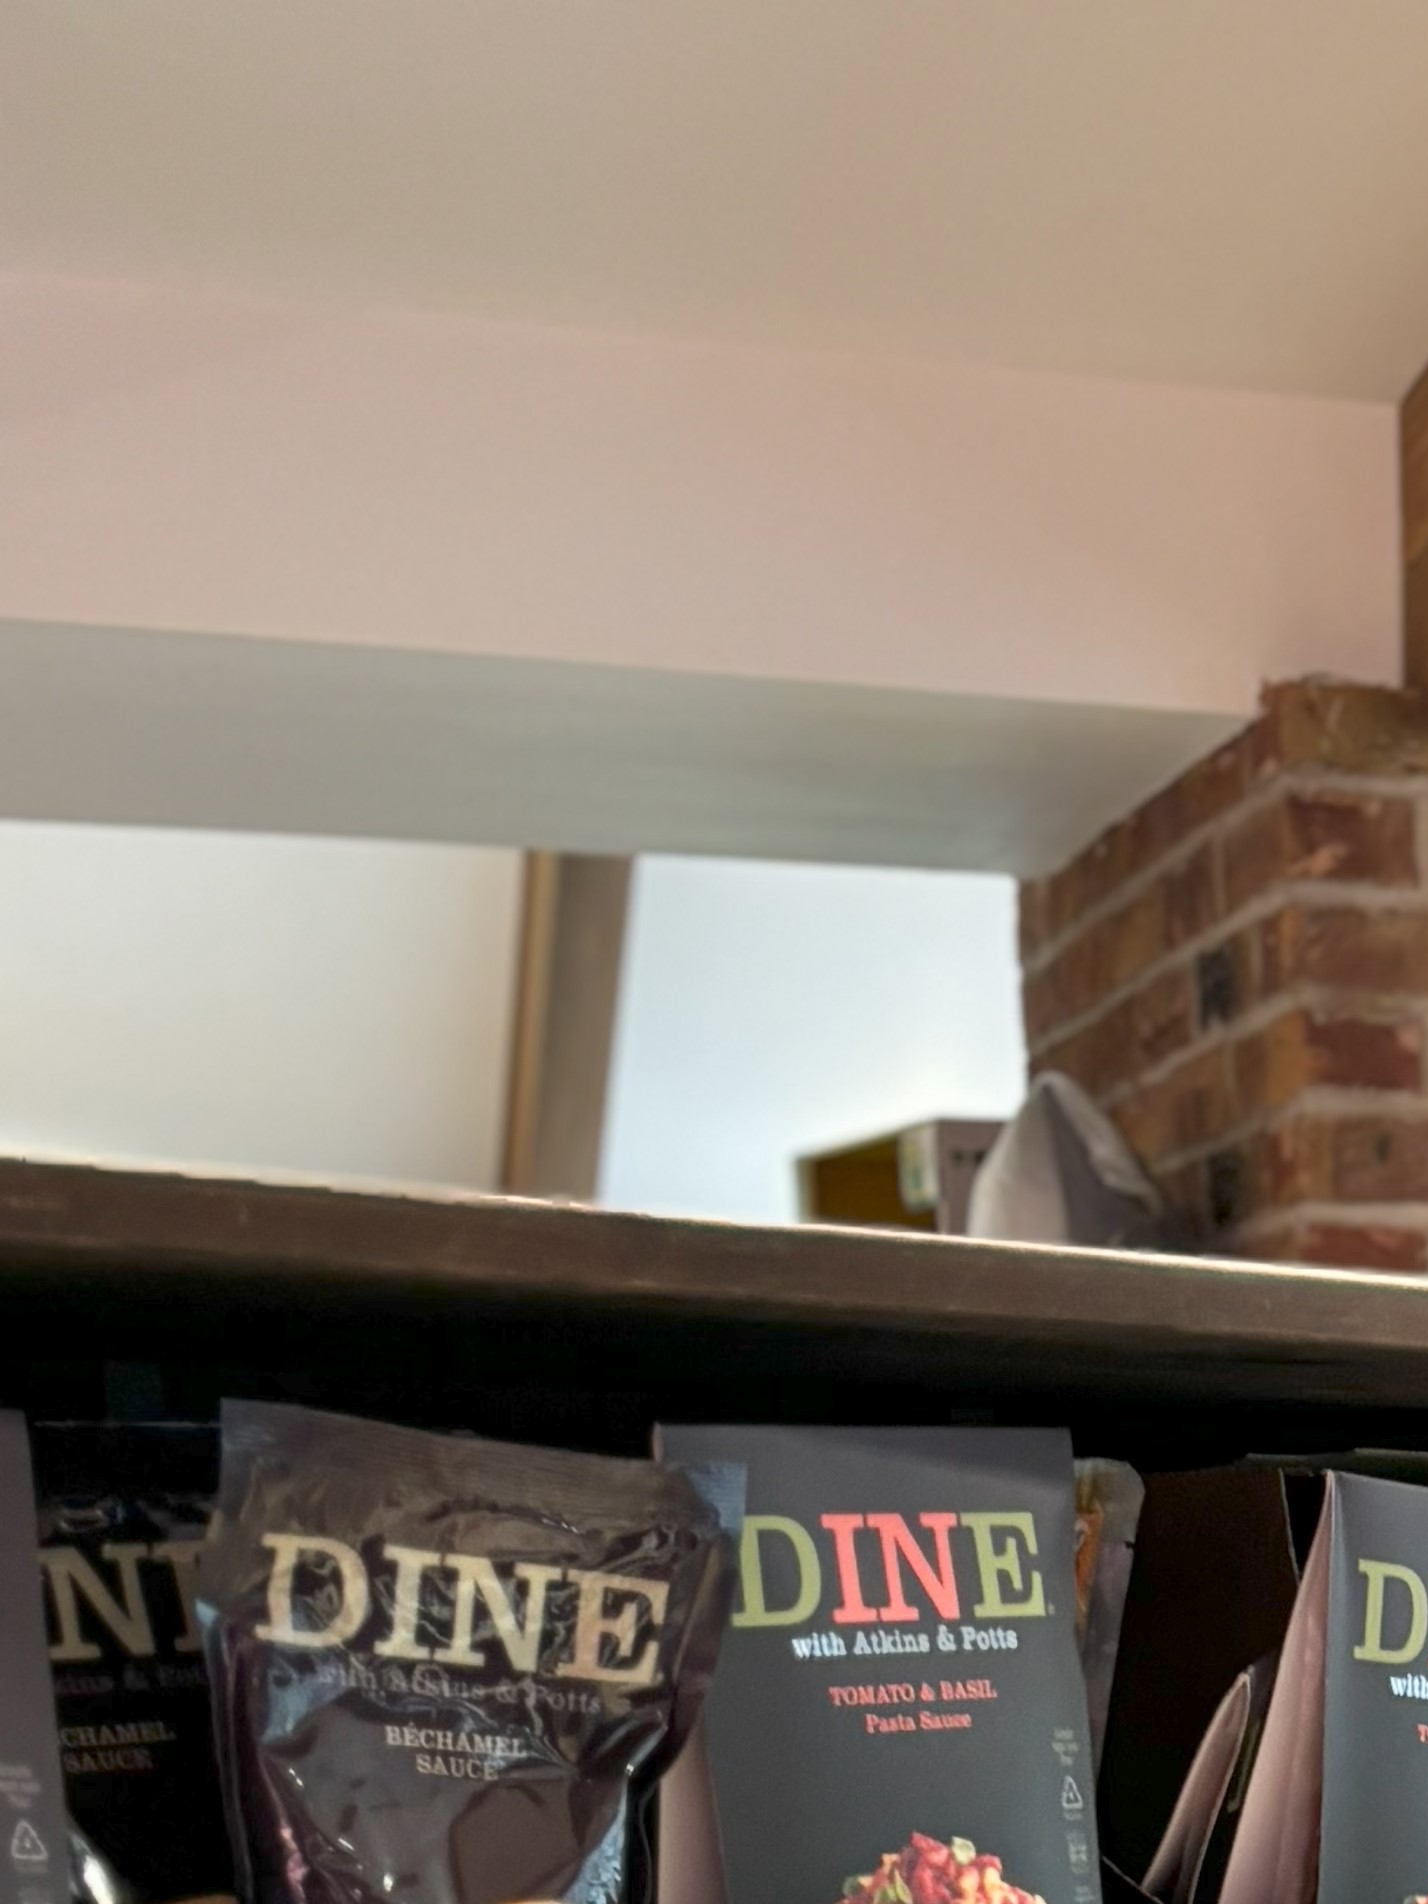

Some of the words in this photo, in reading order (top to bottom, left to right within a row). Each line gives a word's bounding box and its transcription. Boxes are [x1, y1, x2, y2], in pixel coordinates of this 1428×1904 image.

[732, 1511, 1045, 1628] DINE
[255, 1533, 669, 1684] DINE
[791, 1635, 847, 1660] with
[853, 1629, 929, 1656] Atkins
[937, 1629, 955, 1651] &
[961, 1626, 1018, 1653] Potts
[829, 1683, 914, 1708] TOMATO
[921, 1683, 935, 1702] &
[940, 1680, 997, 1702] BASIL
[864, 1713, 916, 1733] Pasta
[920, 1710, 971, 1730] Sauce
